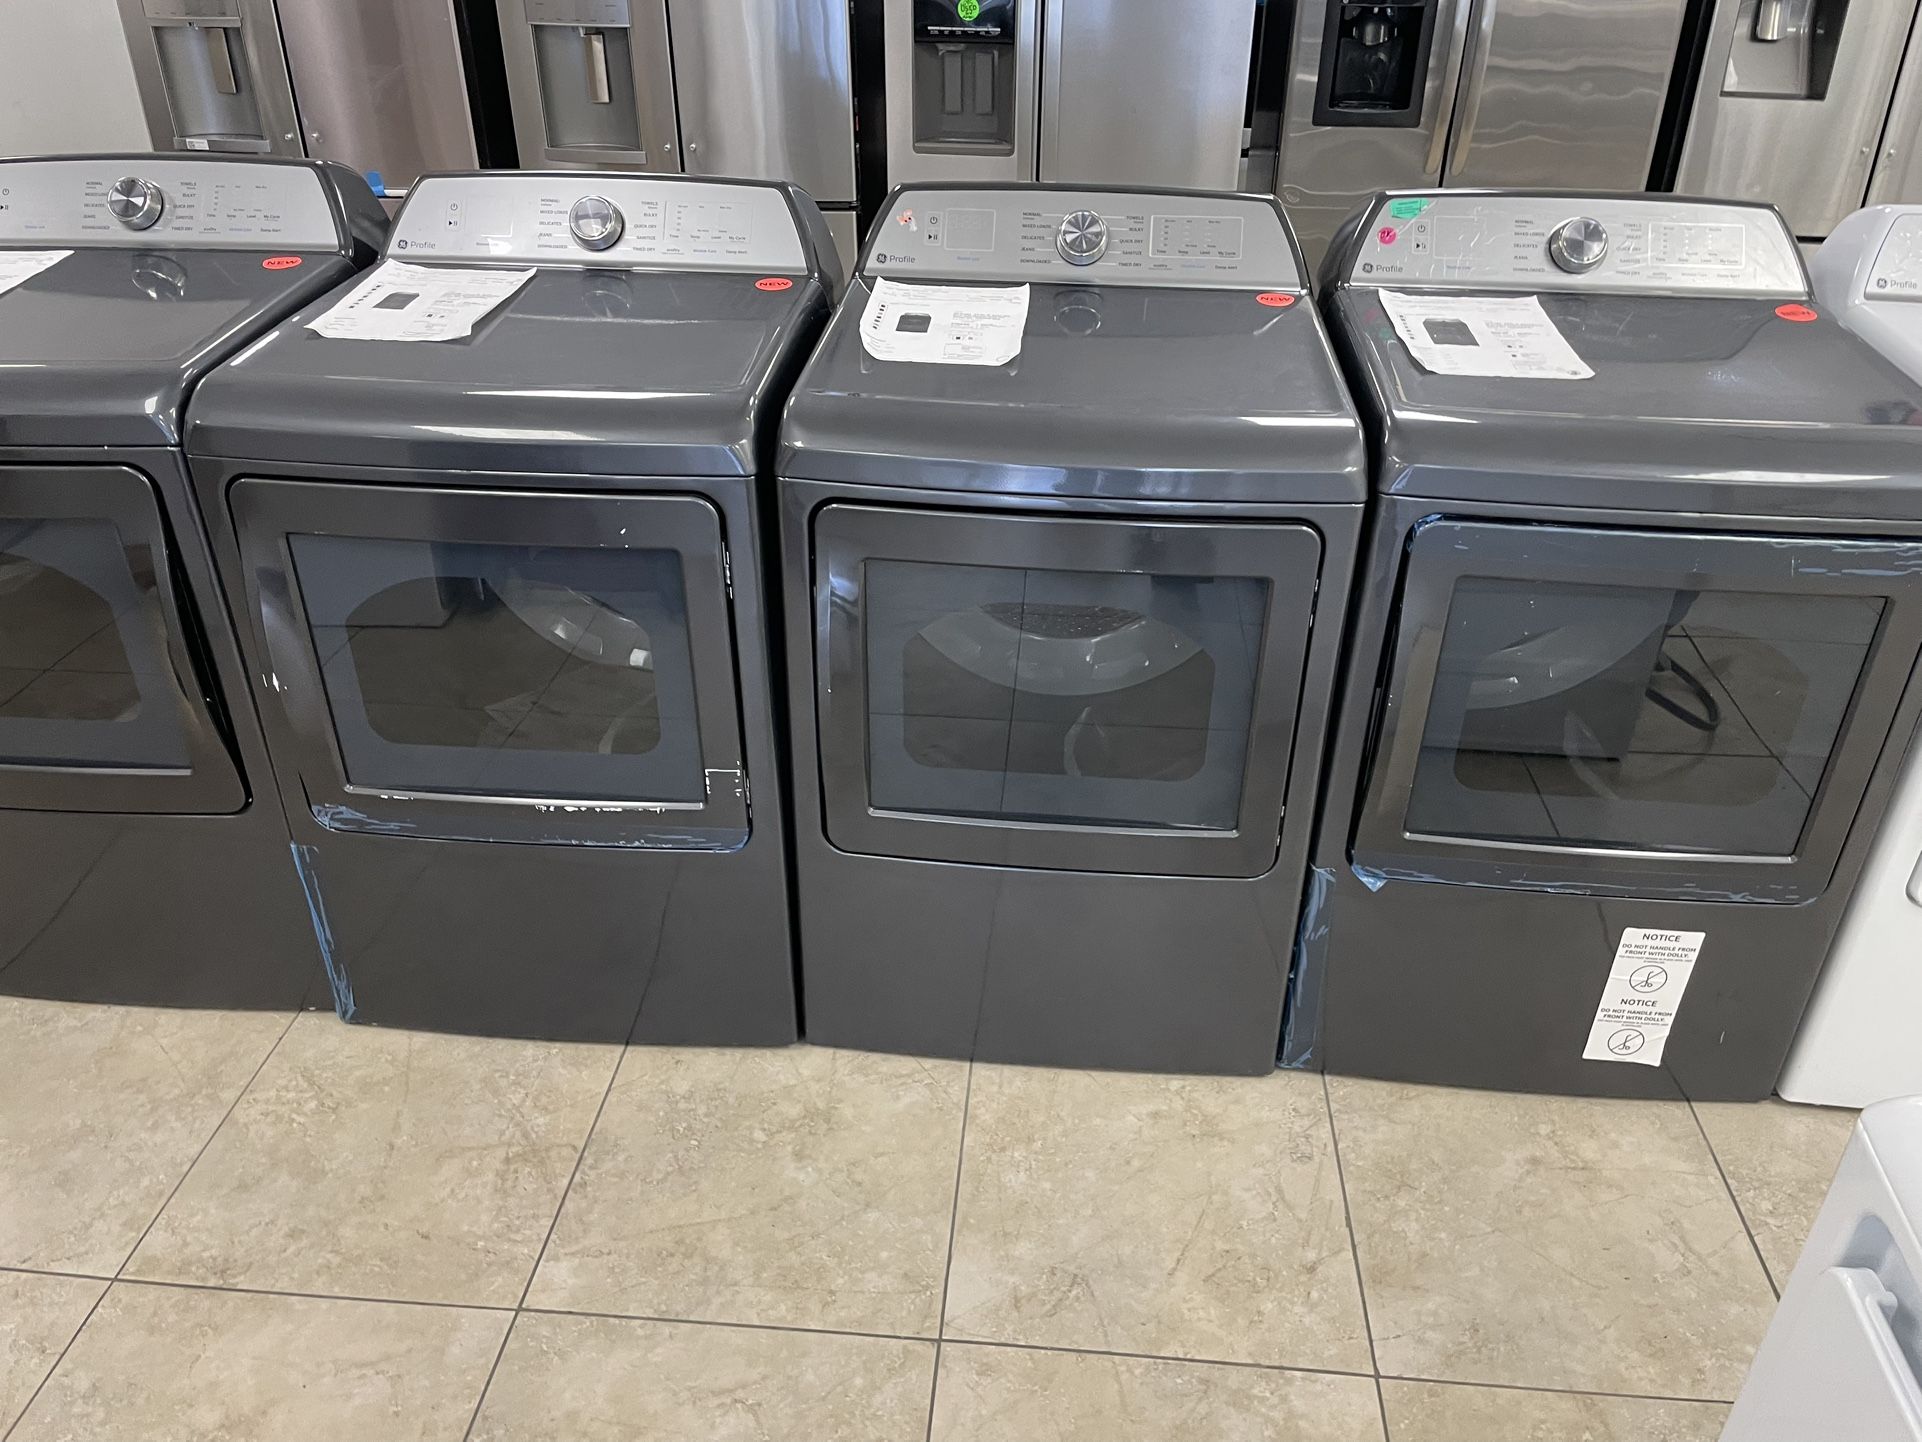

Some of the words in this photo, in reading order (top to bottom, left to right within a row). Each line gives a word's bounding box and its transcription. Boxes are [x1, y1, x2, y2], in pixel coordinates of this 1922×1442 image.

[410, 240, 436, 249] Profile
[889, 254, 916, 263] Profile
[1376, 264, 1404, 273] Profile
[1890, 279, 1918, 289] Profile
[1642, 933, 1682, 942] NOTICE
[1620, 998, 1658, 1007] NOTICE
